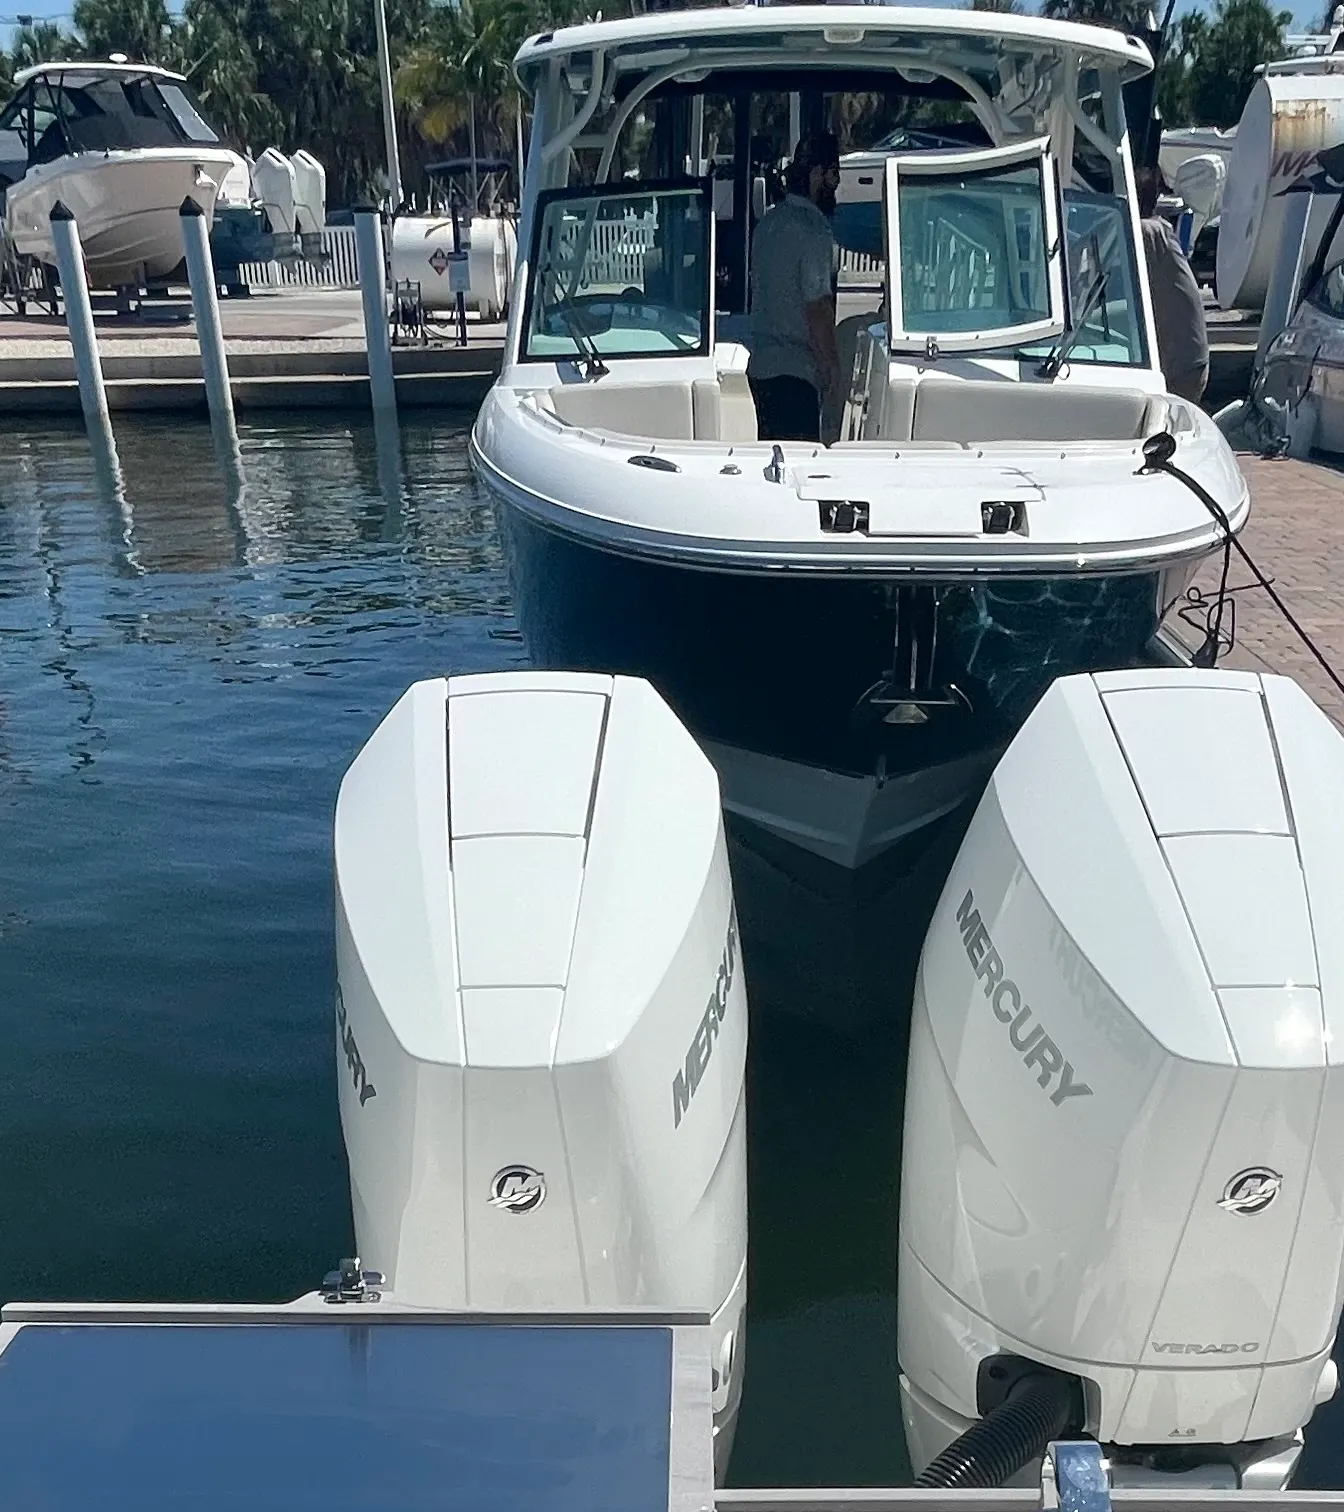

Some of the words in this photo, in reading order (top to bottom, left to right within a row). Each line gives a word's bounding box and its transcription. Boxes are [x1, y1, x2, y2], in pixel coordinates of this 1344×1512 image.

[336, 981, 377, 1108] CURY
[672, 899, 738, 1129] MERCUR
[956, 887, 1094, 1108] MERCURY
[1152, 1342, 1259, 1355] VERADO
